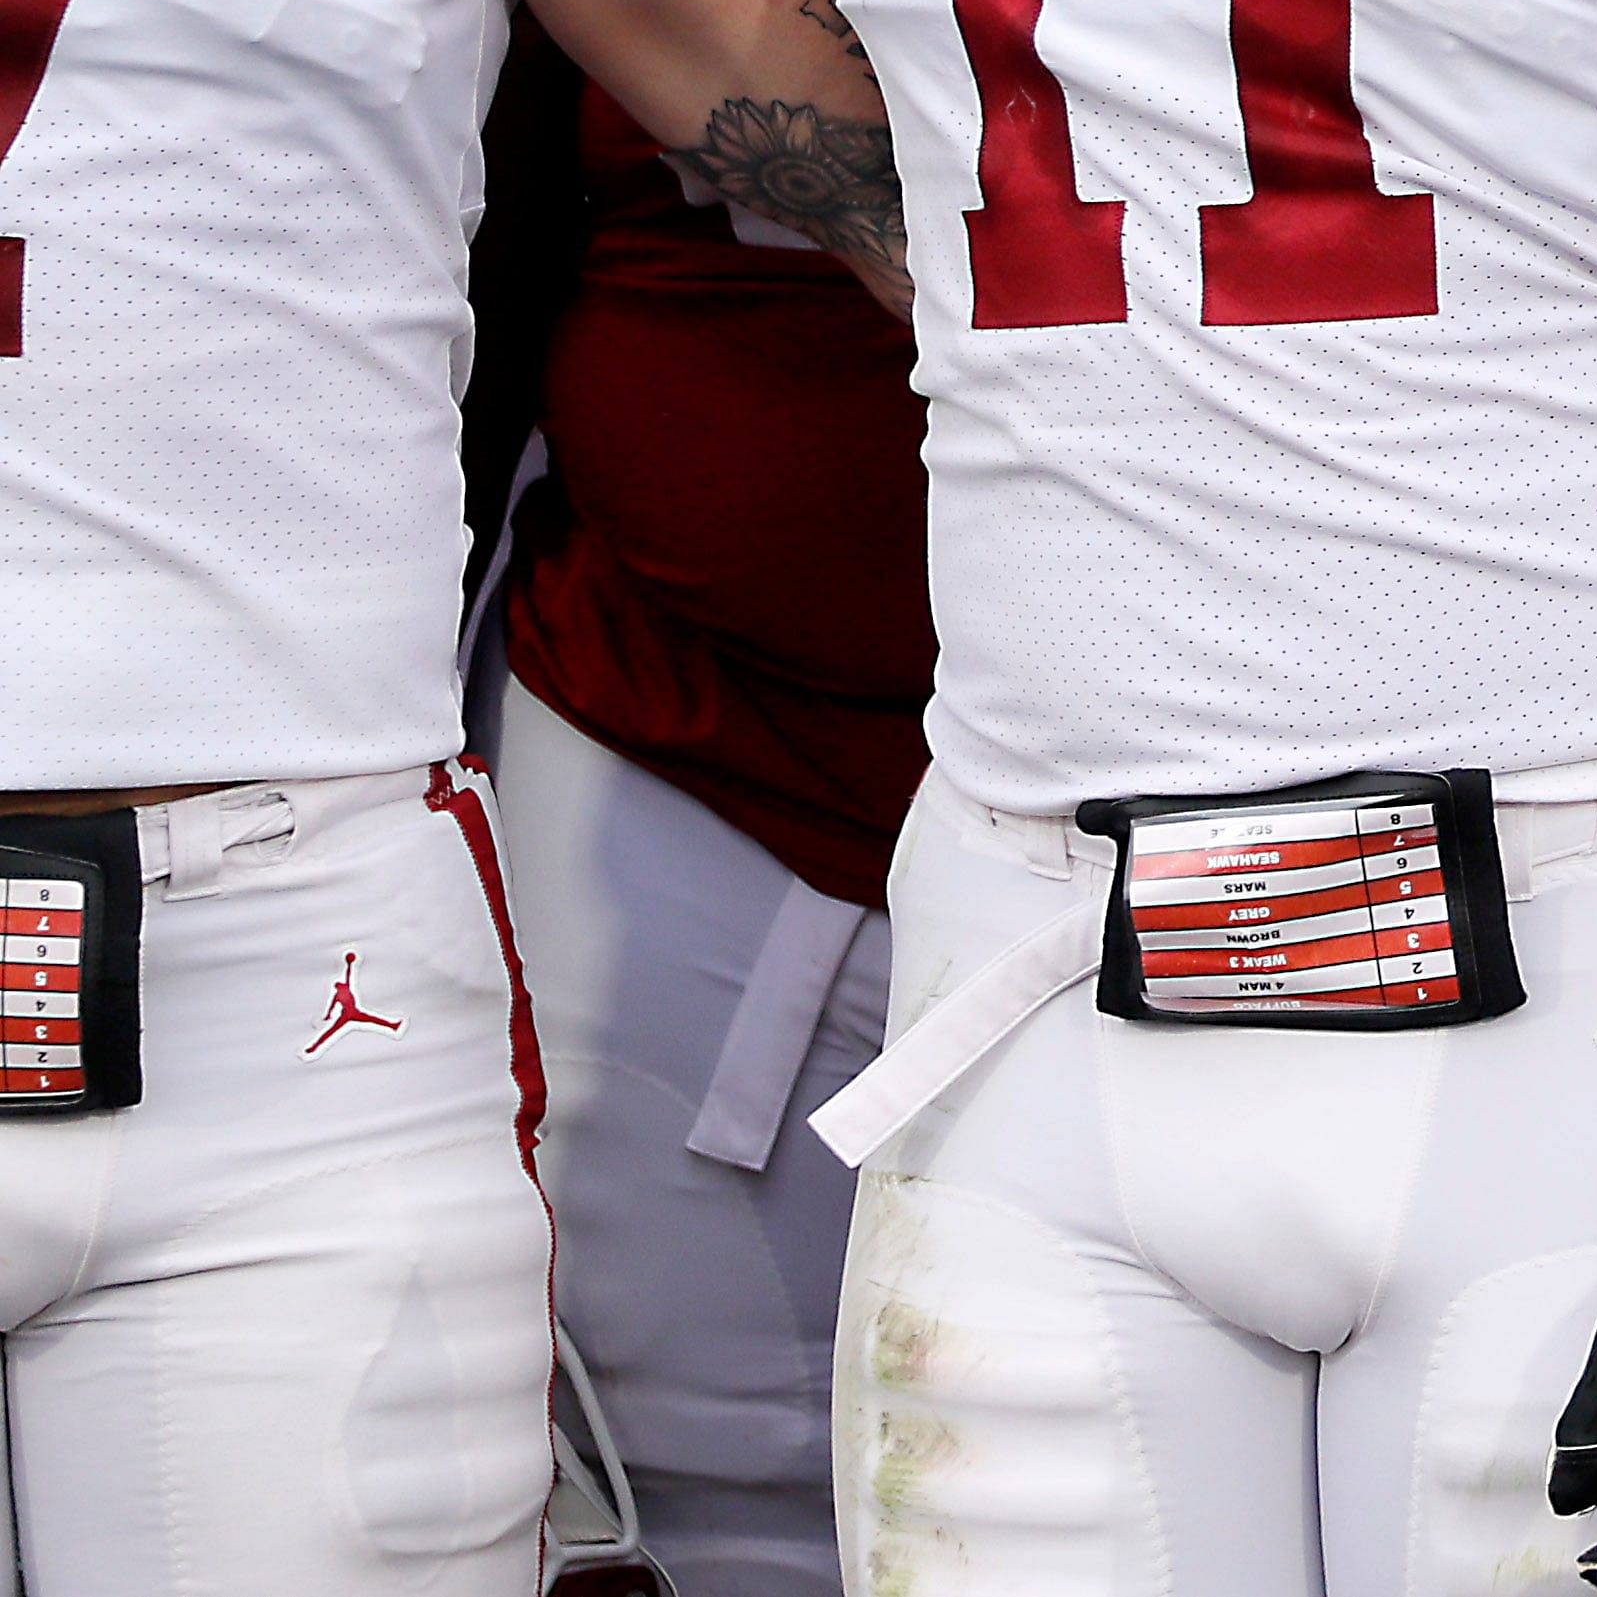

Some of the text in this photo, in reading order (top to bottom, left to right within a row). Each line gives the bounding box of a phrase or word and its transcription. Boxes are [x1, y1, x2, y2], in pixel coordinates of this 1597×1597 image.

[1390, 813, 1401, 825] 8
[1206, 834, 1405, 869] 7 SEAHAWK
[1224, 857, 1407, 893] 6 MARS
[40, 888, 50, 901] 8
[1228, 880, 1412, 921] 5 GREY
[37, 916, 50, 931] 7
[1226, 907, 1415, 943] 4 BROWN
[37, 945, 47, 957] 6
[1229, 932, 1420, 968] 3 WEAK 3
[35, 971, 48, 986] 5
[1238, 962, 1423, 991] 2 4 MAN
[1417, 987, 1428, 1001] 1
[36, 1001, 47, 1012] 4
[35, 1025, 48, 1039] 3
[37, 1051, 48, 1063] 2
[39, 1075, 51, 1089] 1
